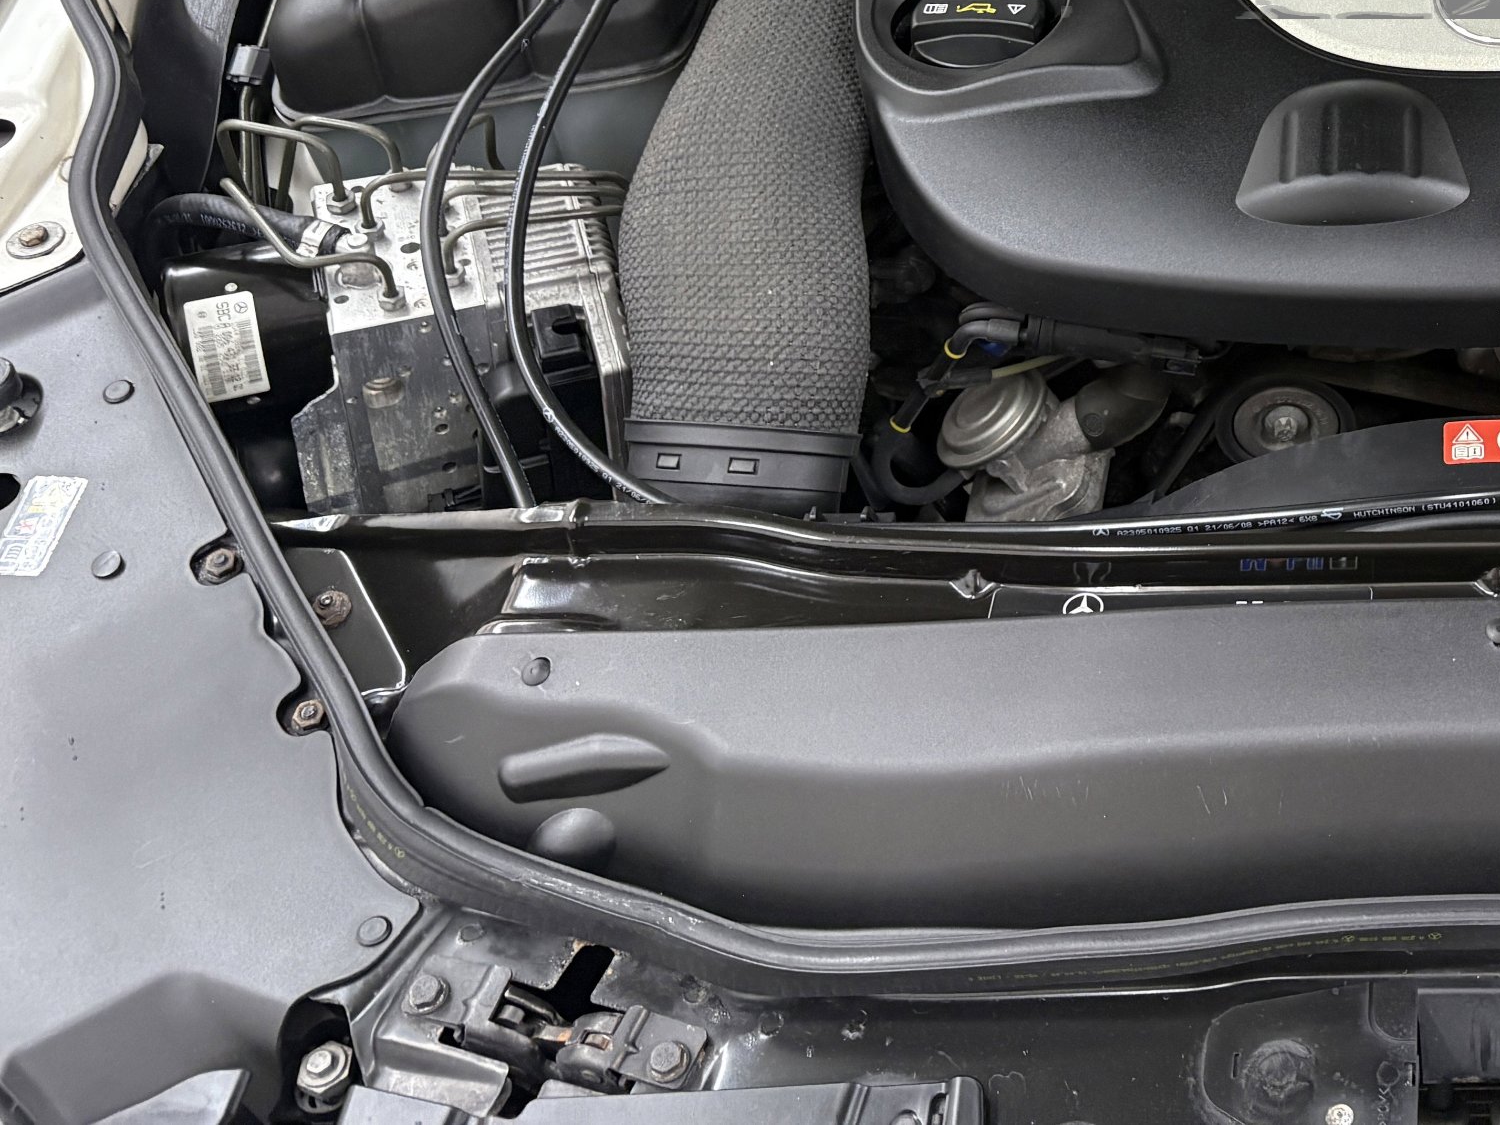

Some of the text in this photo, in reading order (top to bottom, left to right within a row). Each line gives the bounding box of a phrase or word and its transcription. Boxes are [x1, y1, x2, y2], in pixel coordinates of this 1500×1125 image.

[216, 301, 232, 321] SBC
[1116, 525, 1182, 536] A2305010925
[1204, 520, 1252, 531] 21/06/08
[1353, 505, 1416, 518] HUTCHINSON
